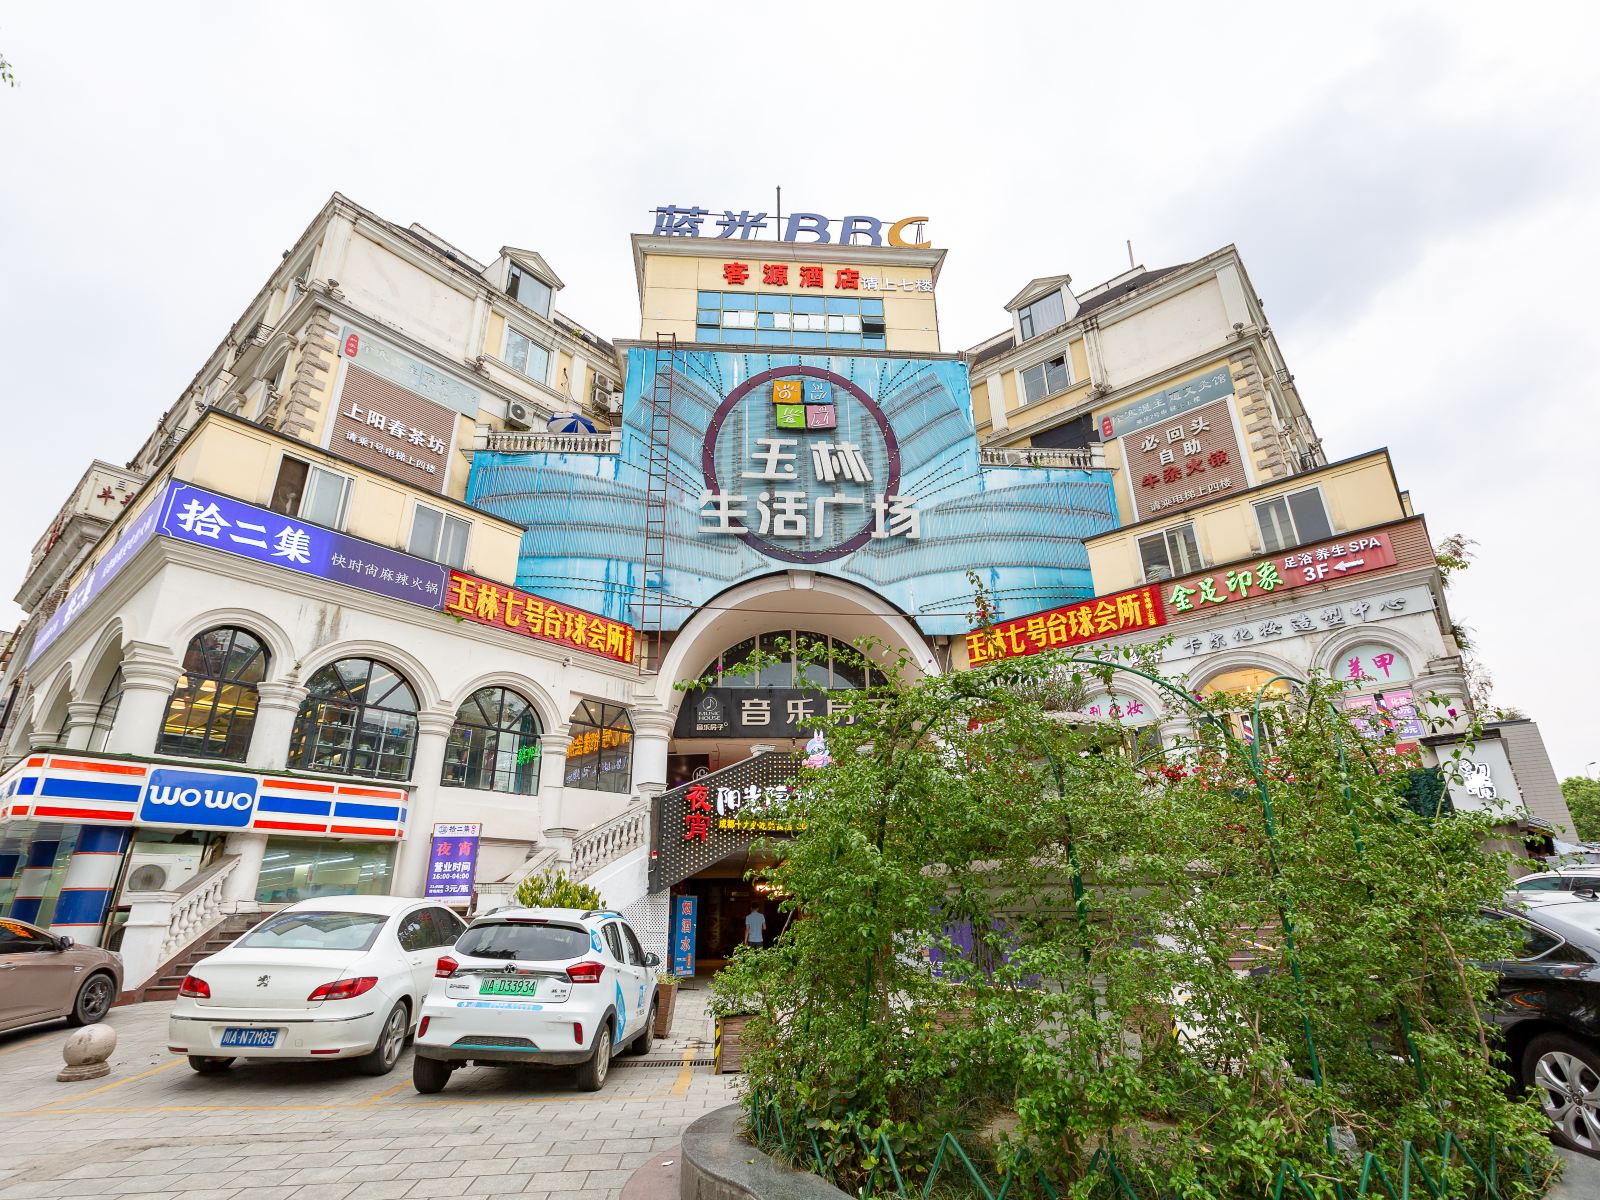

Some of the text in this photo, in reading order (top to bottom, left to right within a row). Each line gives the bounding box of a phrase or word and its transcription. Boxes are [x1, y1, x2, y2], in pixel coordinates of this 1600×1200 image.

[653, 204, 768, 239] 蓝光
[723, 262, 860, 290] 客源酒店
[860, 275, 933, 293] 请上七楼
[343, 403, 446, 455] 上阳春茶坊
[1141, 416, 1211, 452] 必回头
[741, 438, 873, 483] 玉林
[1142, 450, 1229, 489] 牛杂火锅
[1160, 438, 1202, 466] 自助
[176, 498, 311, 564] 拾二集
[698, 489, 920, 539] 生活广场
[1284, 537, 1381, 569] 足浴养生 SPA
[1303, 563, 1328, 581] 3F
[331, 552, 439, 595] 快时尚麻辣火锅
[1169, 561, 1284, 611] 金足印象
[448, 575, 626, 657] 玉林七号台球会所
[966, 593, 1142, 663] 玉林七号台球会所
[1184, 598, 1406, 654] 卡尔化妆造型中心
[1345, 653, 1394, 682] 美甲
[684, 783, 712, 841] 夜宵
[434, 861, 472, 872] 营业时间
[437, 841, 472, 857] 夜宵
